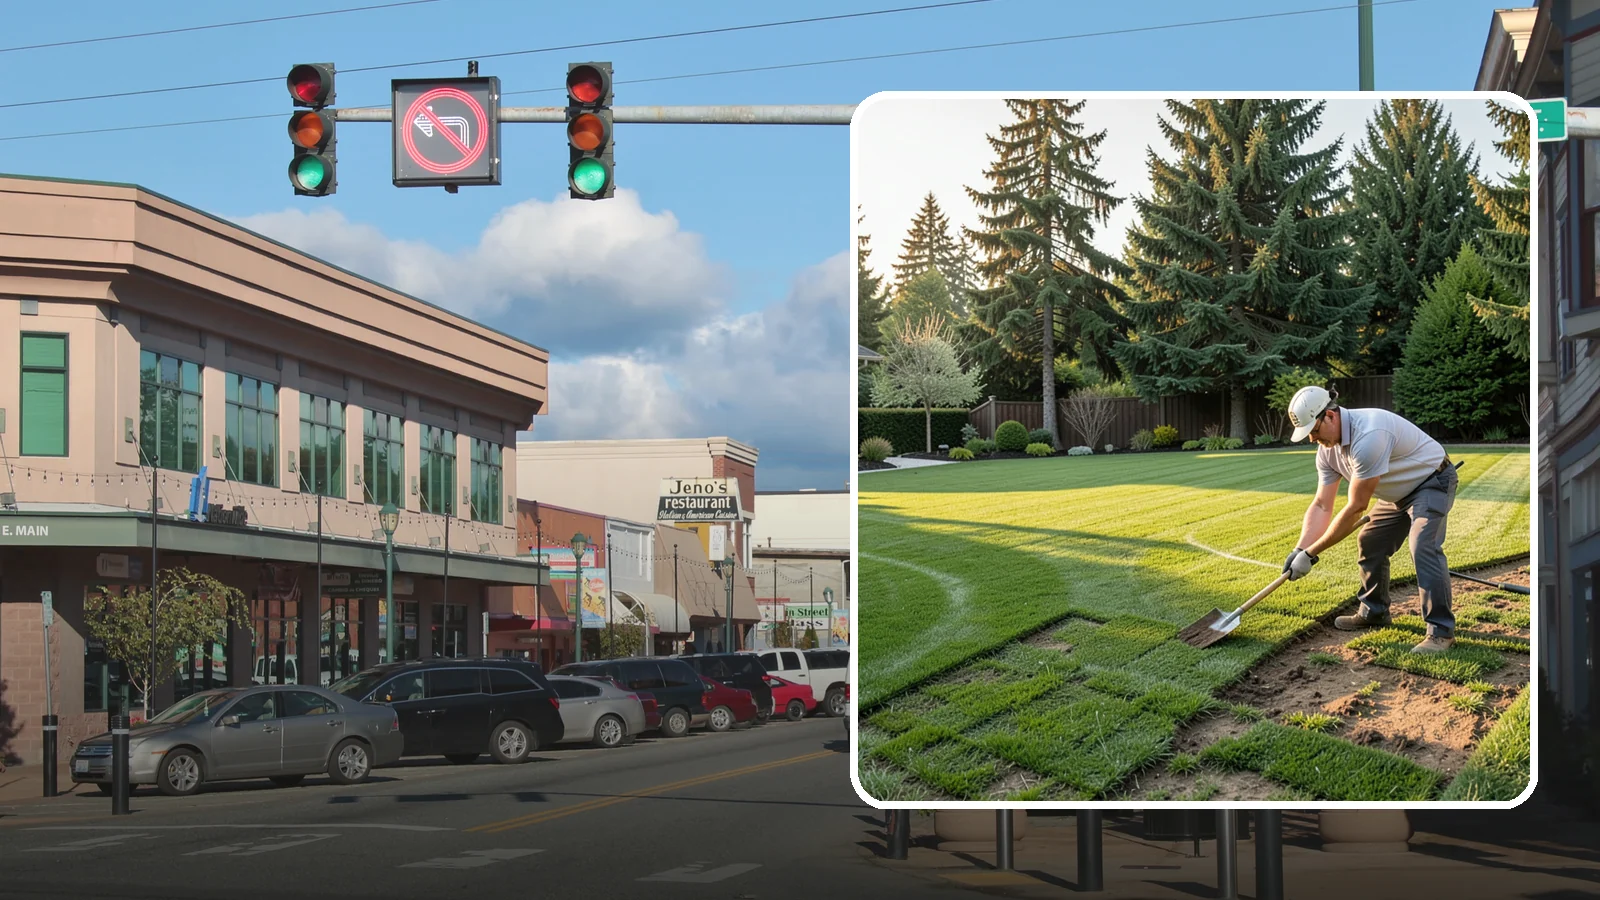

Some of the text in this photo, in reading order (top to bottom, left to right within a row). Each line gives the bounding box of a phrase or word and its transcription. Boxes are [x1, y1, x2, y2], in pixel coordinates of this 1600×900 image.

[669, 480, 728, 495] Jeno's
[665, 496, 731, 509] restaurant
[659, 510, 682, 520] Italian
[686, 509, 714, 519] American
[715, 509, 738, 519] Cuisine
[15, 525, 49, 536] MAIN
[785, 608, 795, 616] in
[797, 607, 828, 616] Street
[787, 619, 823, 627] lass
